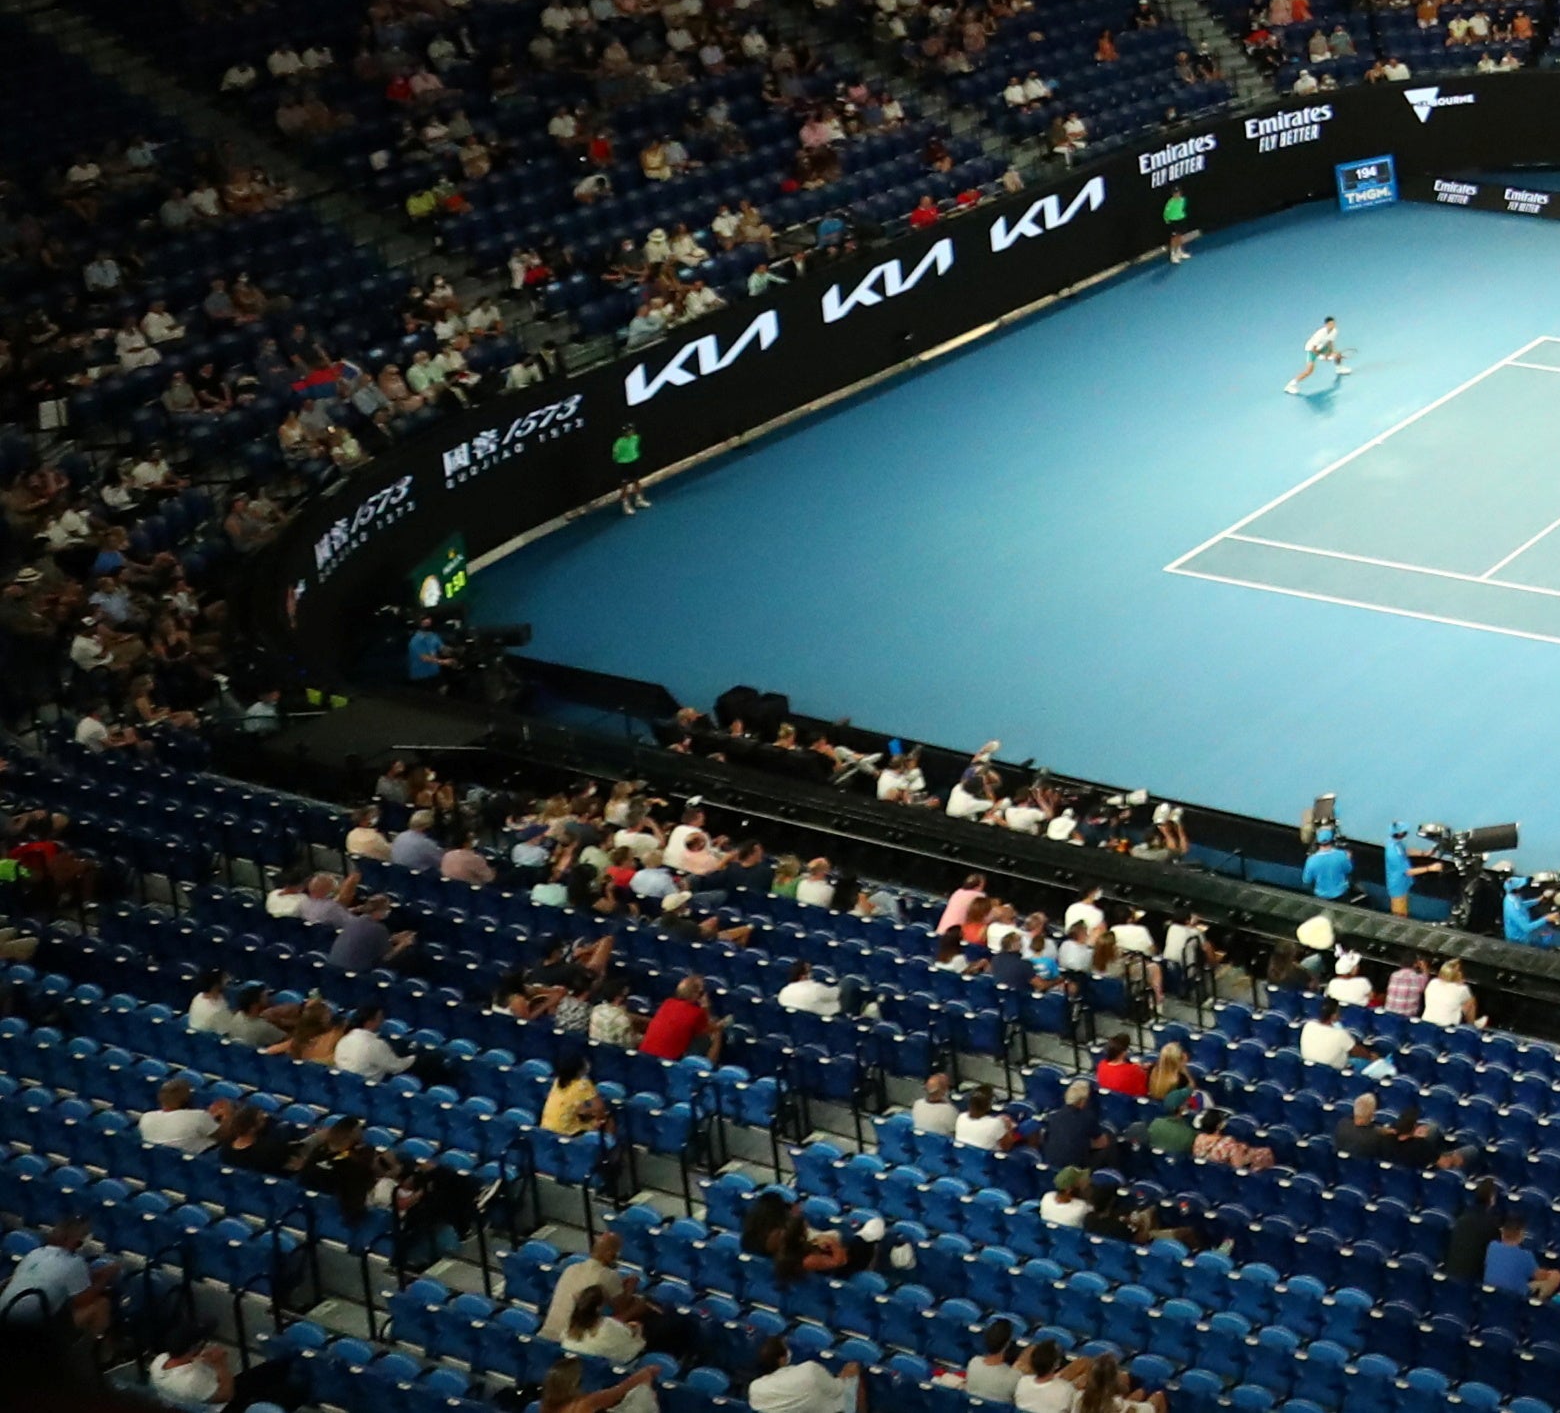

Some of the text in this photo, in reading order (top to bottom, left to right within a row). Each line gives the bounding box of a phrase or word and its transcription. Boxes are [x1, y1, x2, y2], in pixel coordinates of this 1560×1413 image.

[1245, 104, 1334, 140] Emirates
[1258, 124, 1321, 154] FLY BETTER
[1138, 133, 1217, 175] Emirates
[1151, 154, 1205, 189] FLY BETTER
[1356, 165, 1377, 180] 194
[1434, 179, 1478, 197] Emirates
[1504, 188, 1549, 205] Emirates
[990, 176, 1104, 253] KIA
[822, 238, 955, 324] KIA
[625, 309, 779, 407] KIA
